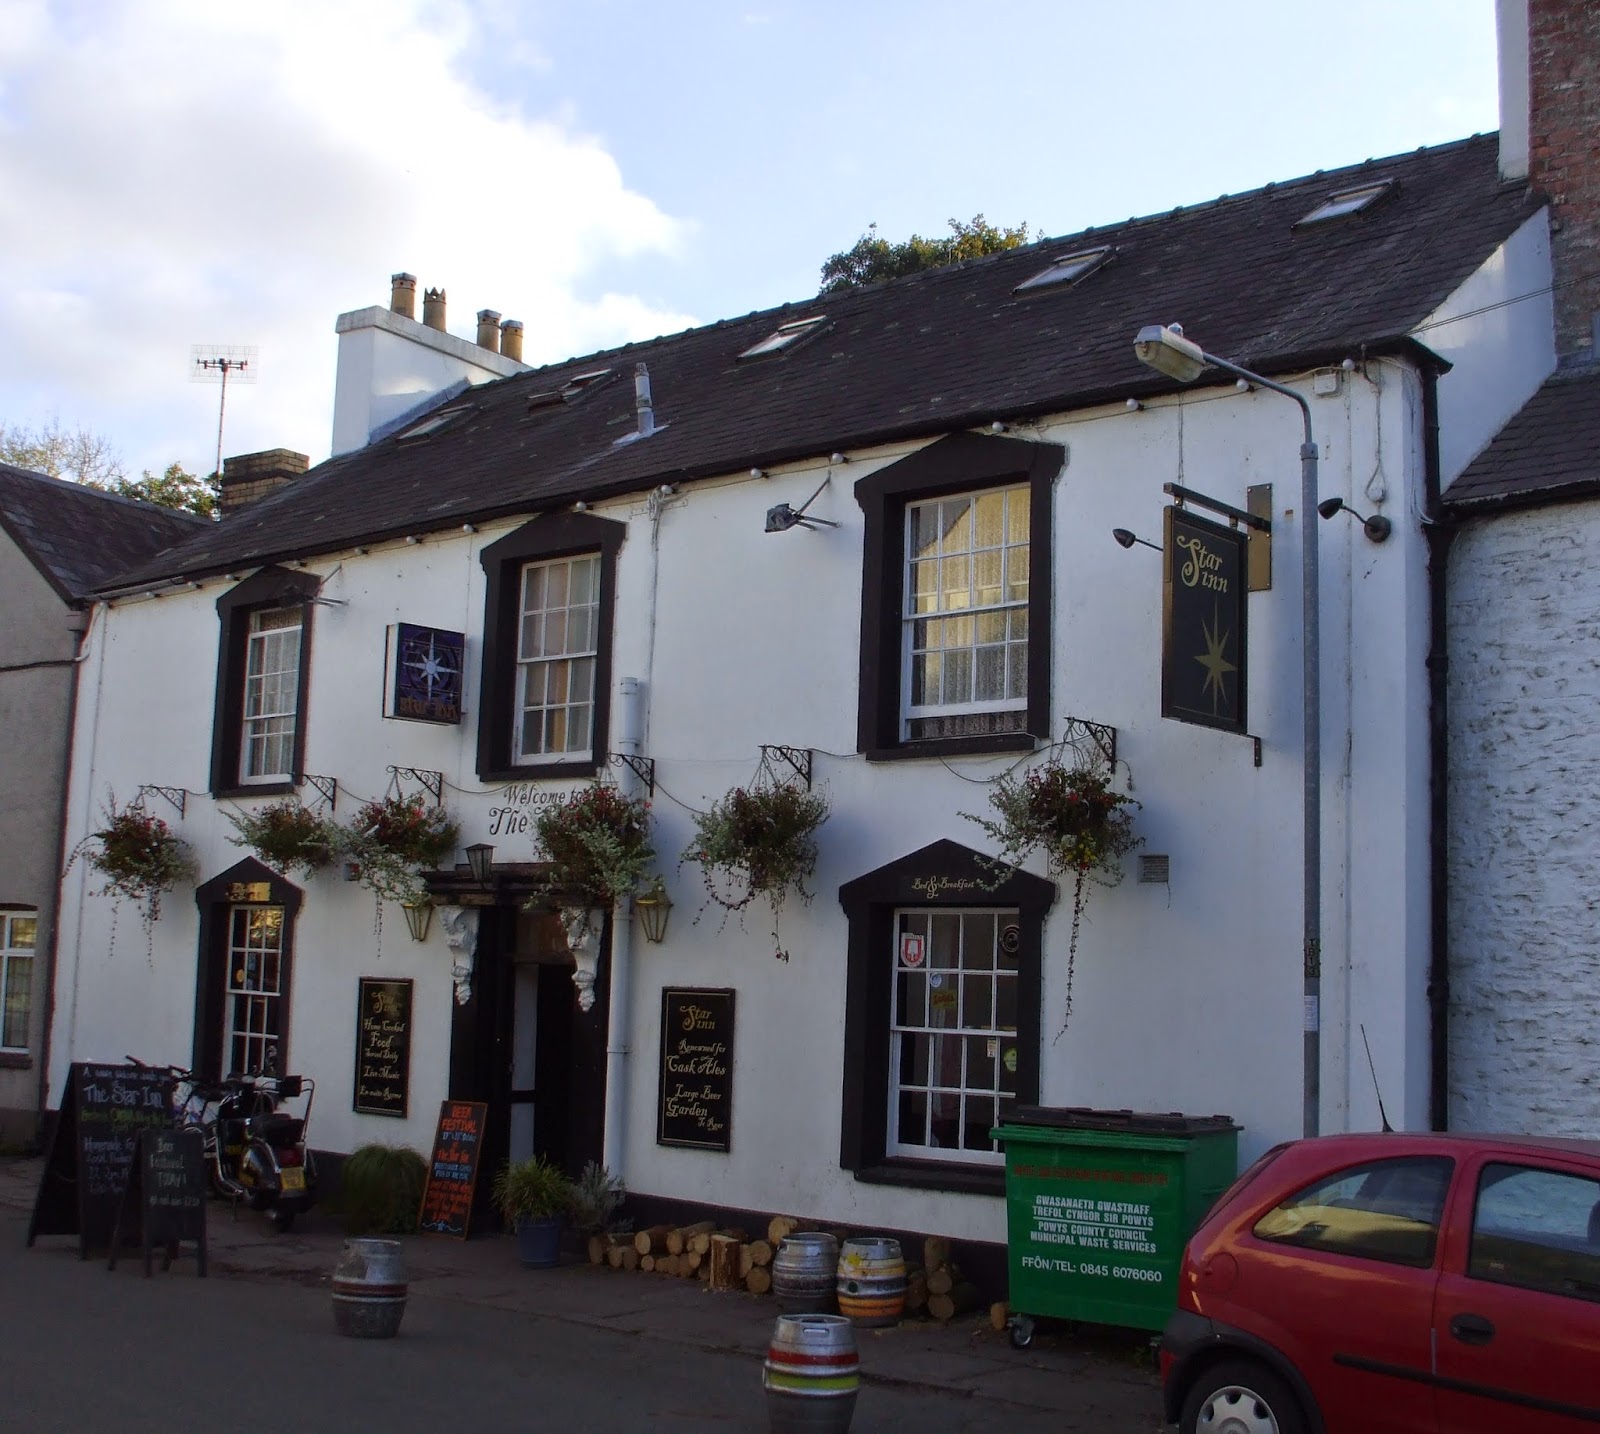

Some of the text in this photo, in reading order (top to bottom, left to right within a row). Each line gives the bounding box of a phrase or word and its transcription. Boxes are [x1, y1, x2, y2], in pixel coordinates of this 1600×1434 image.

[1176, 535, 1223, 587] Star
[503, 783, 584, 806] Welcome to
[489, 807, 528, 835] The
[911, 877, 930, 890] Bed
[938, 876, 975, 892] Breakfast
[679, 1005, 712, 1031] Star
[370, 1031, 395, 1047] Food
[678, 1038, 726, 1056] Renowned for
[363, 1065, 401, 1080] Live Music
[667, 1055, 726, 1076] Cask Ales
[83, 1083, 110, 1103] The
[112, 1084, 141, 1105] Star
[675, 1084, 722, 1102] Large Beer
[666, 1097, 708, 1118] Garden
[441, 1118, 478, 1132] FESTIVAL
[1036, 1195, 1150, 1215] GWASANAETH GWASTRAFF
[1032, 1205, 1154, 1227] TREFOL CYNGOR SIR POWYS
[1030, 1230, 1156, 1254] MUNICIPAL WASTE SERVICES
[1038, 1221, 1147, 1242] POWYS COUNTY COUNCIL
[1022, 1255, 1163, 1282] FFÔN/TEL: 0845 6076060
